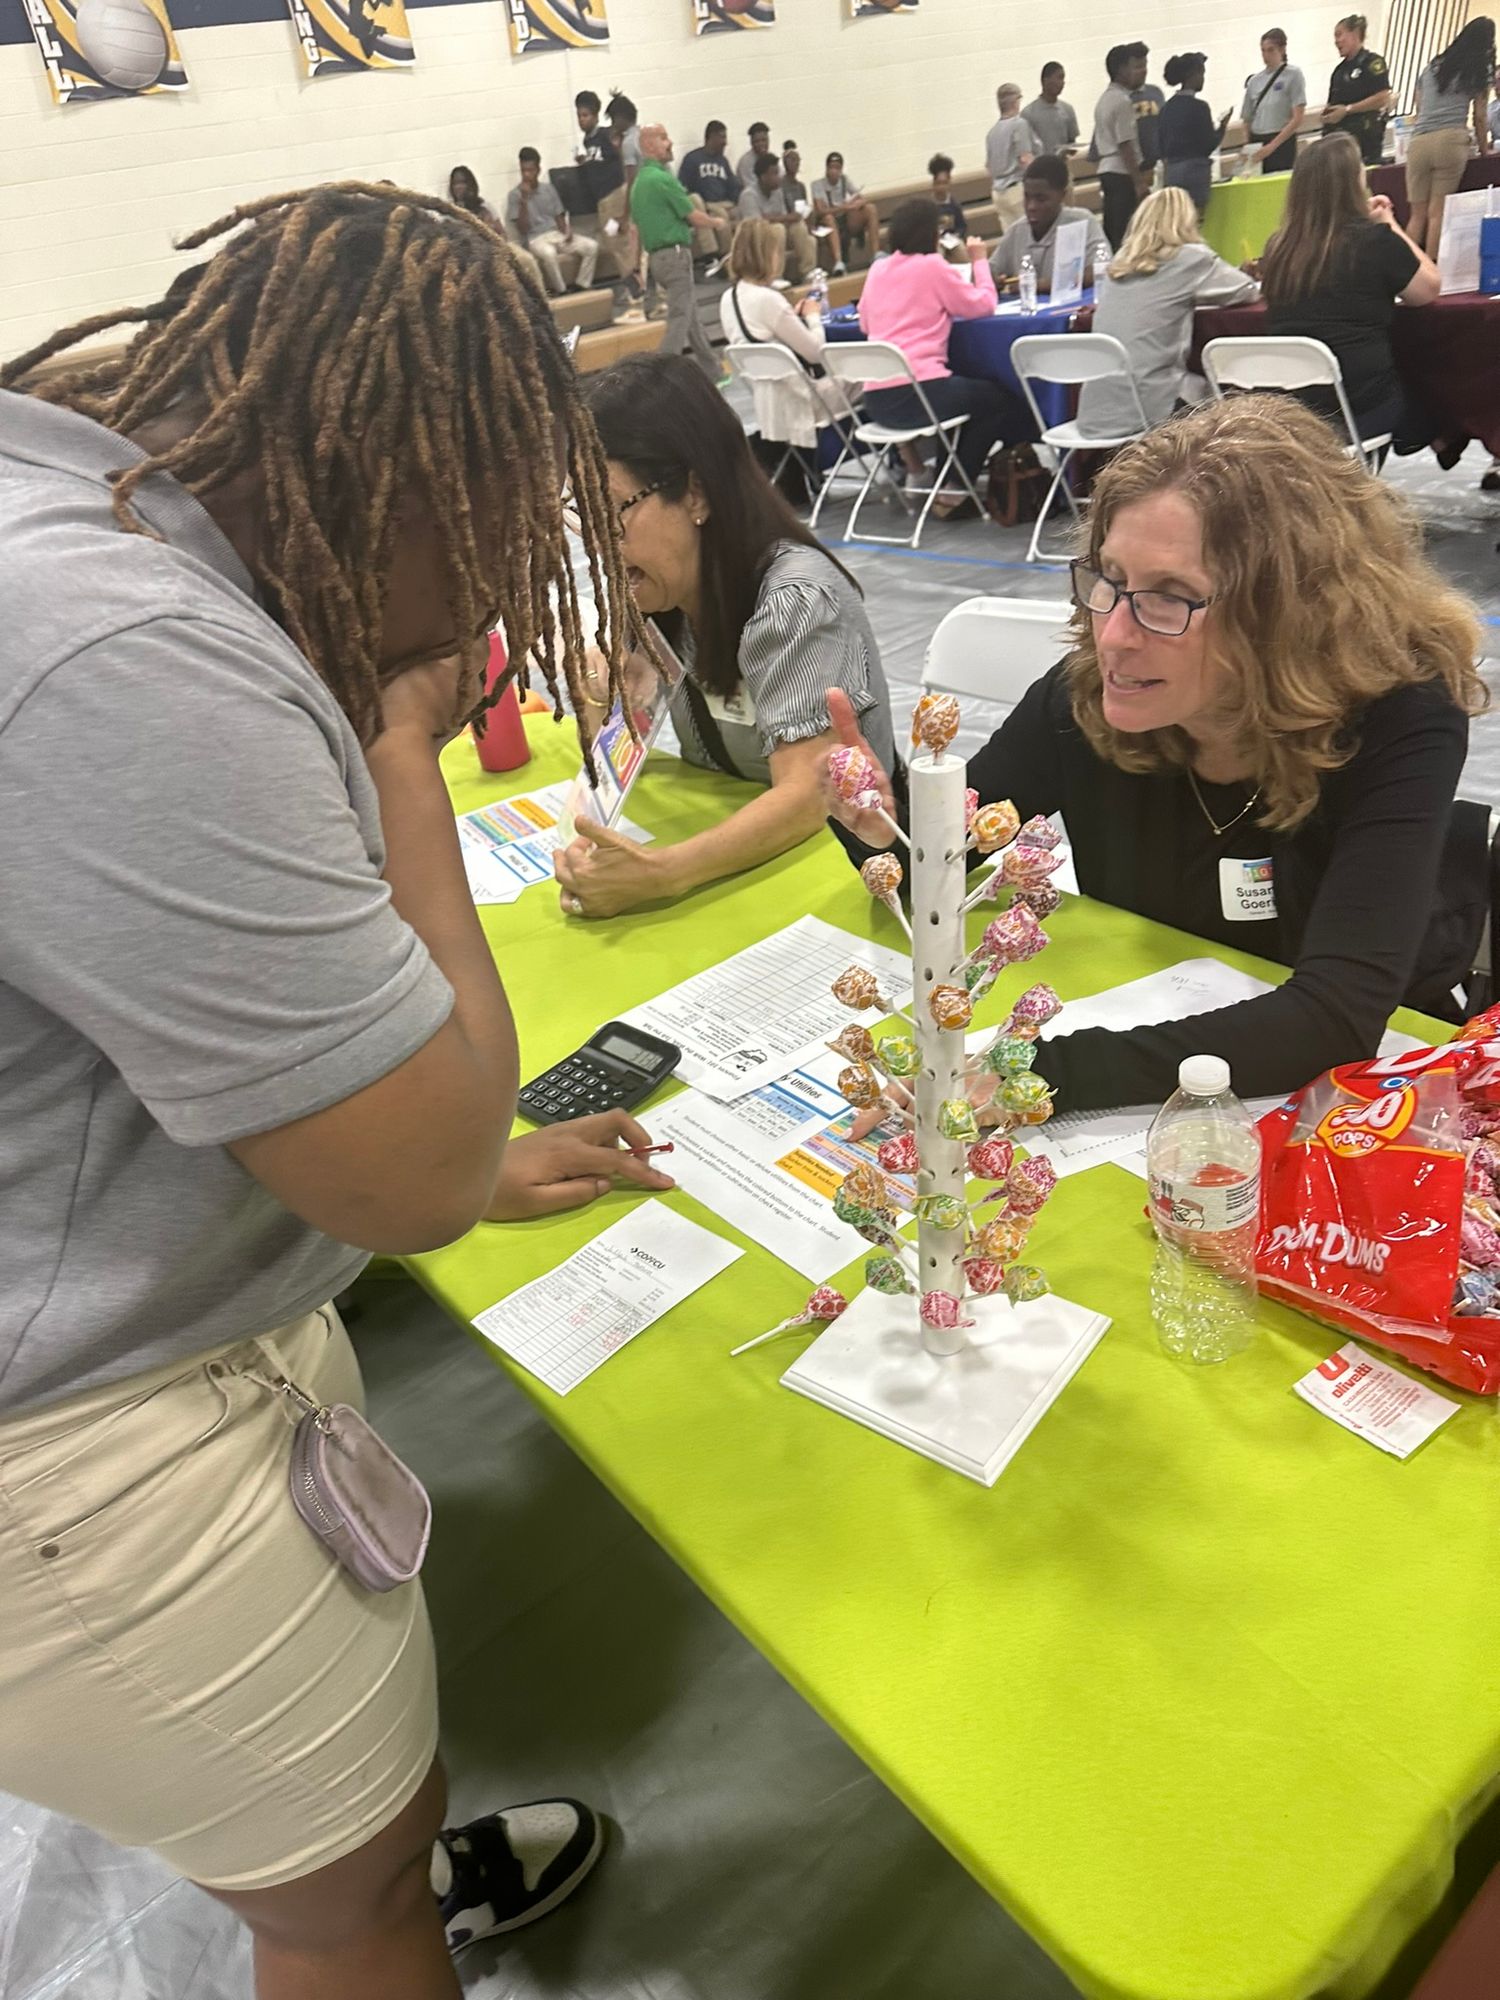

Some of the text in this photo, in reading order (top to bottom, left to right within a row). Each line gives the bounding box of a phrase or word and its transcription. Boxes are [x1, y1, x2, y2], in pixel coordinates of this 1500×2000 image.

[1240, 898, 1275, 910] Goer
[790, 1077, 822, 1099] Utilities
[1333, 1130, 1376, 1148] POPS
[1332, 1362, 1374, 1399] olivetti
